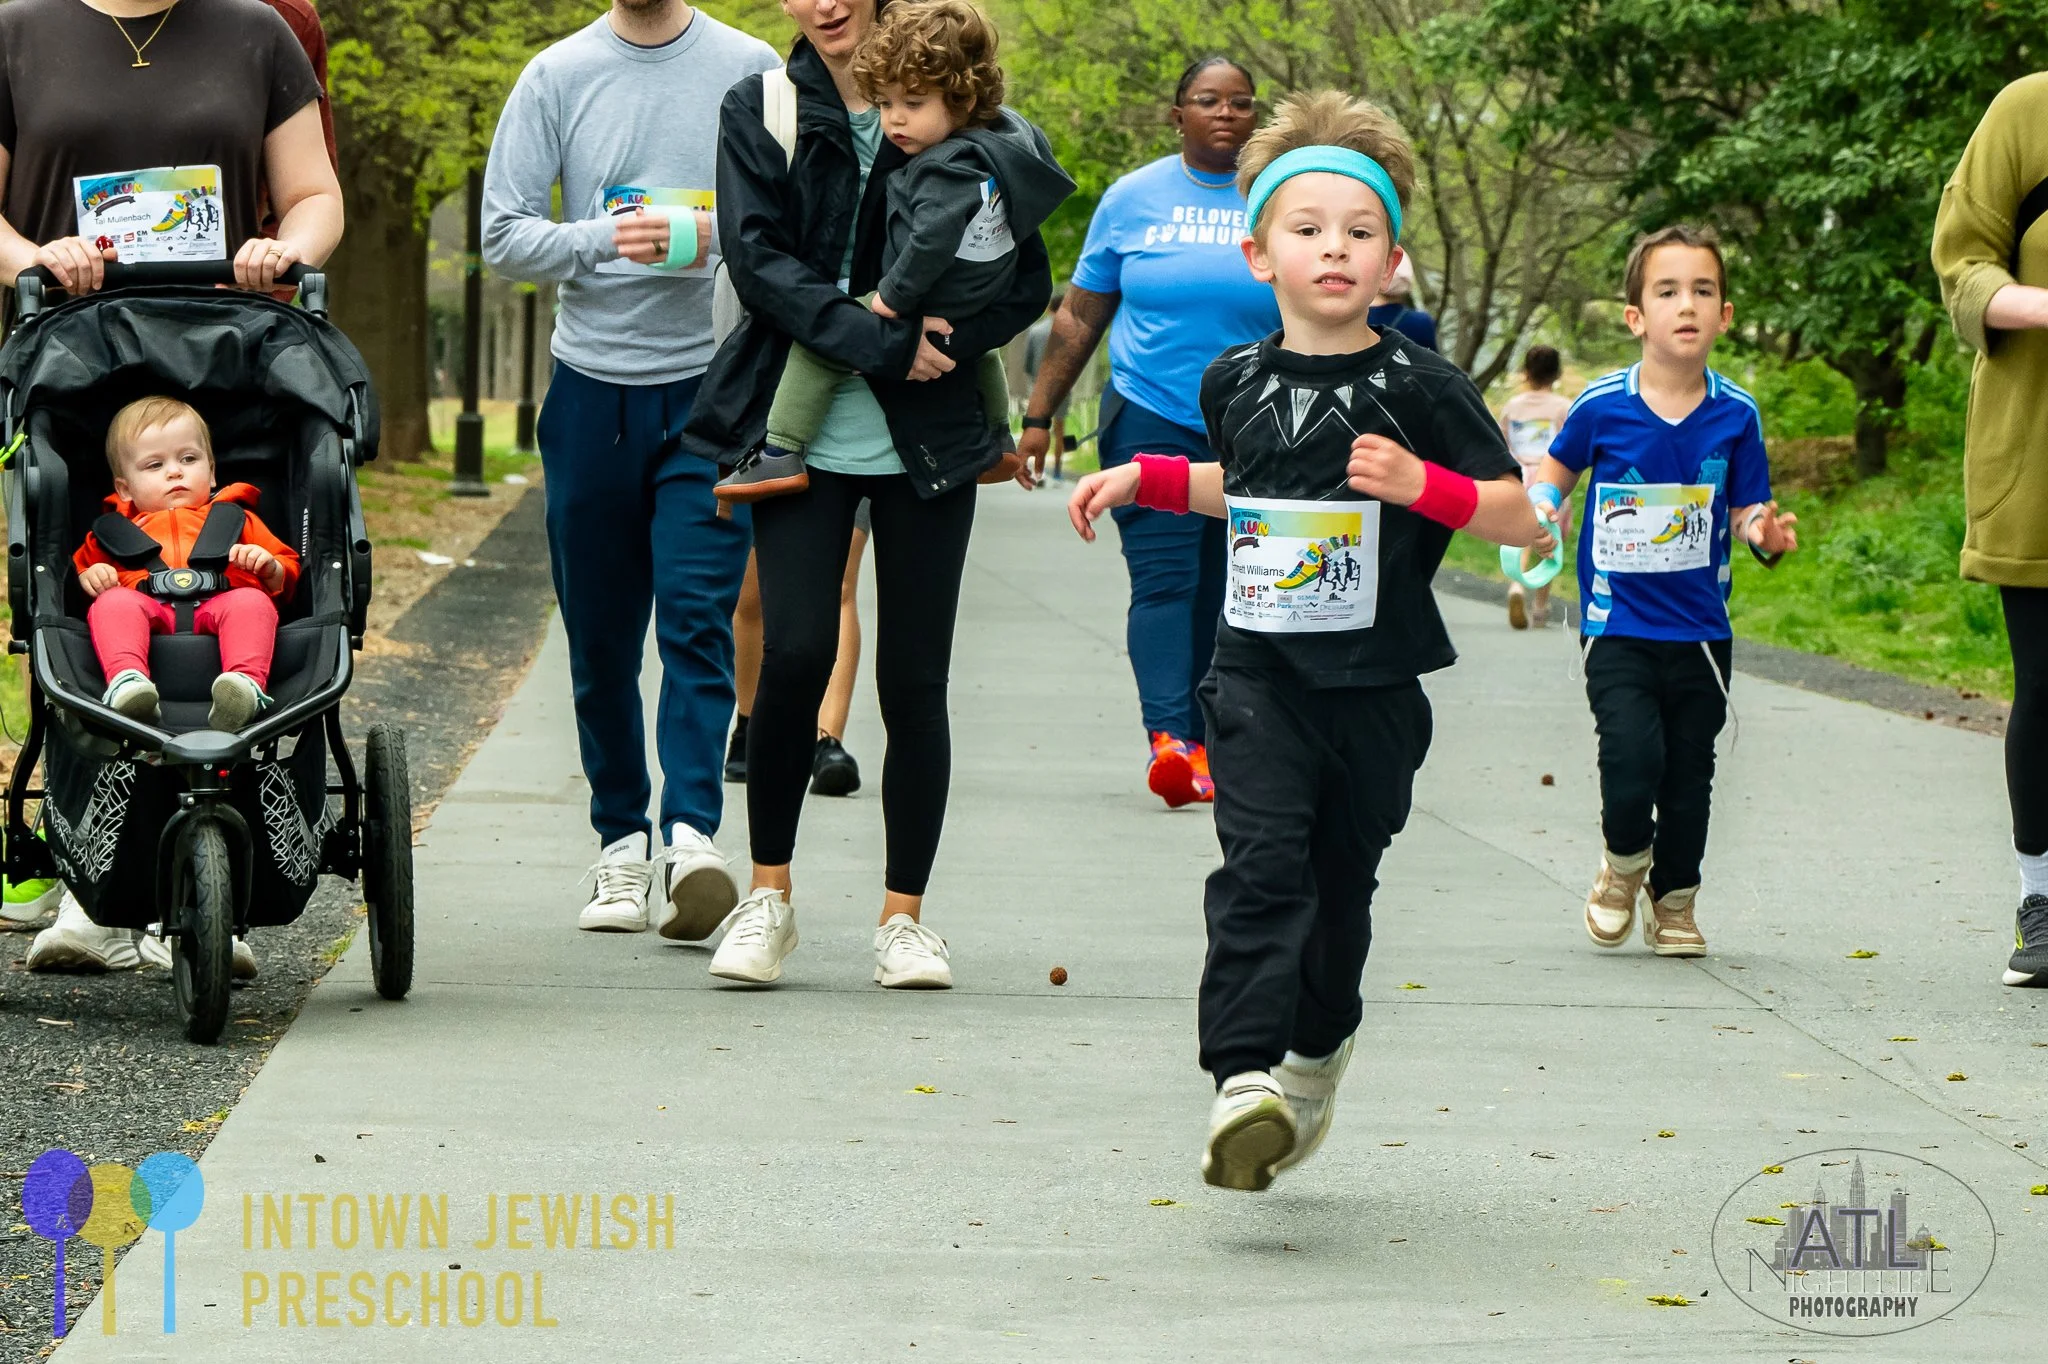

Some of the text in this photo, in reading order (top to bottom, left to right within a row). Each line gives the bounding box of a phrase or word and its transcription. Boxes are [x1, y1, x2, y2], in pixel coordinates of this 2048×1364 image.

[82, 189, 109, 211] FUN
[113, 182, 143, 195] RUN
[107, 214, 151, 224] Mullenbach
[1240, 520, 1270, 537] RUN
[1246, 564, 1285, 577] Williams
